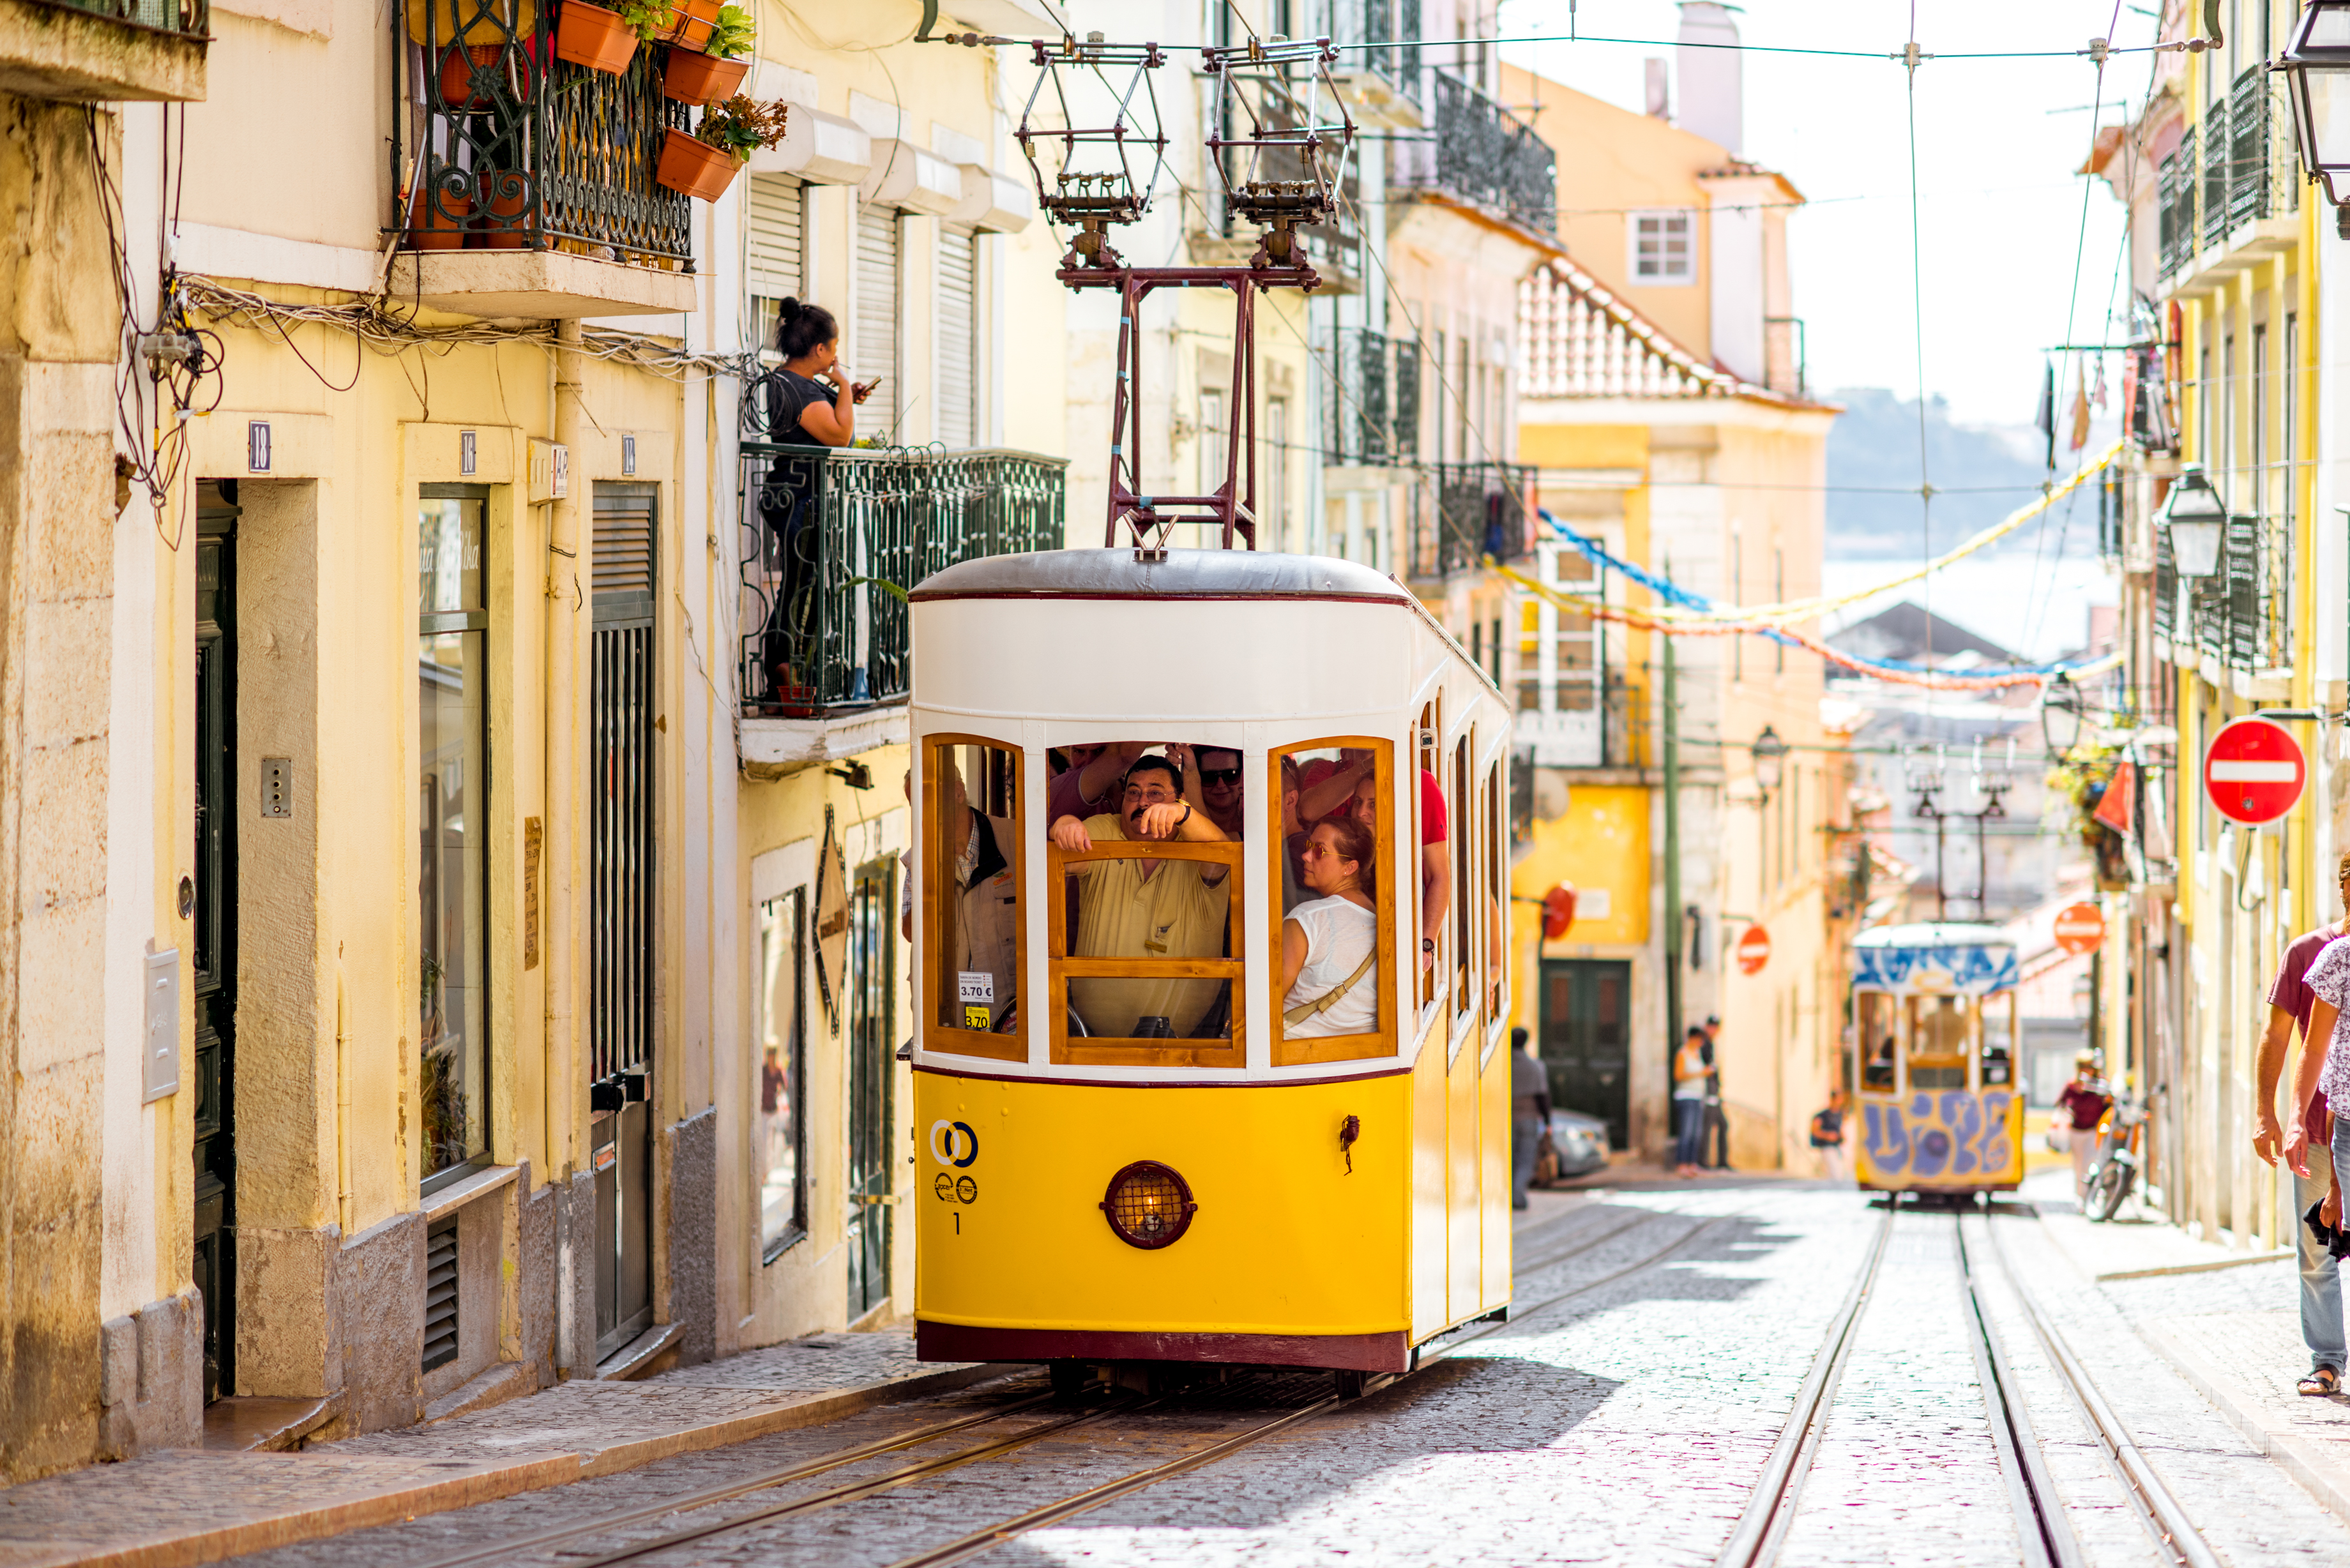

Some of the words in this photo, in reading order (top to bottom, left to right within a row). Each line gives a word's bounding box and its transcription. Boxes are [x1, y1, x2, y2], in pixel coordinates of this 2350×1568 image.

[254, 426, 267, 468] 18
[464, 435, 473, 472] 16
[626, 439, 634, 472] 14
[420, 547, 434, 573] ua
[961, 986, 982, 996] 3.70
[985, 987, 992, 997] €
[966, 1016, 988, 1028] 3.70
[953, 1212, 960, 1235] 1
